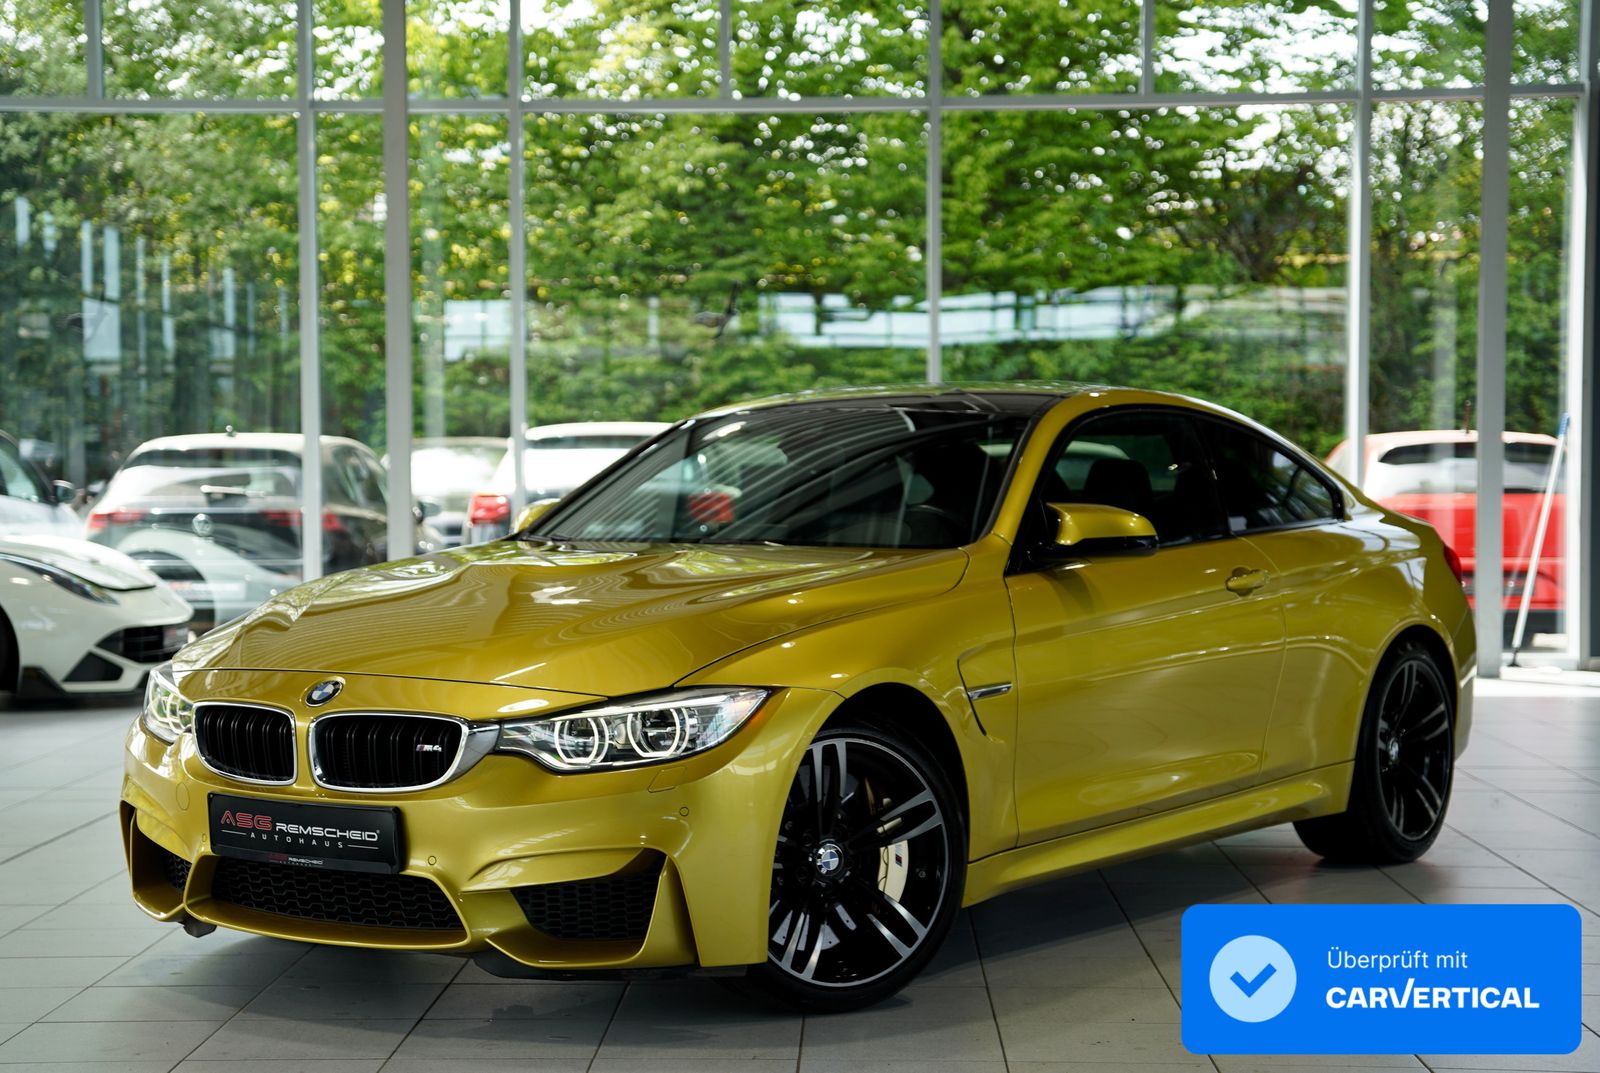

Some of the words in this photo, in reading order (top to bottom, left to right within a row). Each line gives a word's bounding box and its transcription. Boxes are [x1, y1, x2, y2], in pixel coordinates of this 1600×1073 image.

[220, 810, 272, 831] ASG
[275, 822, 379, 842] REMSCHEID
[250, 831, 343, 848] AUTOHAUS
